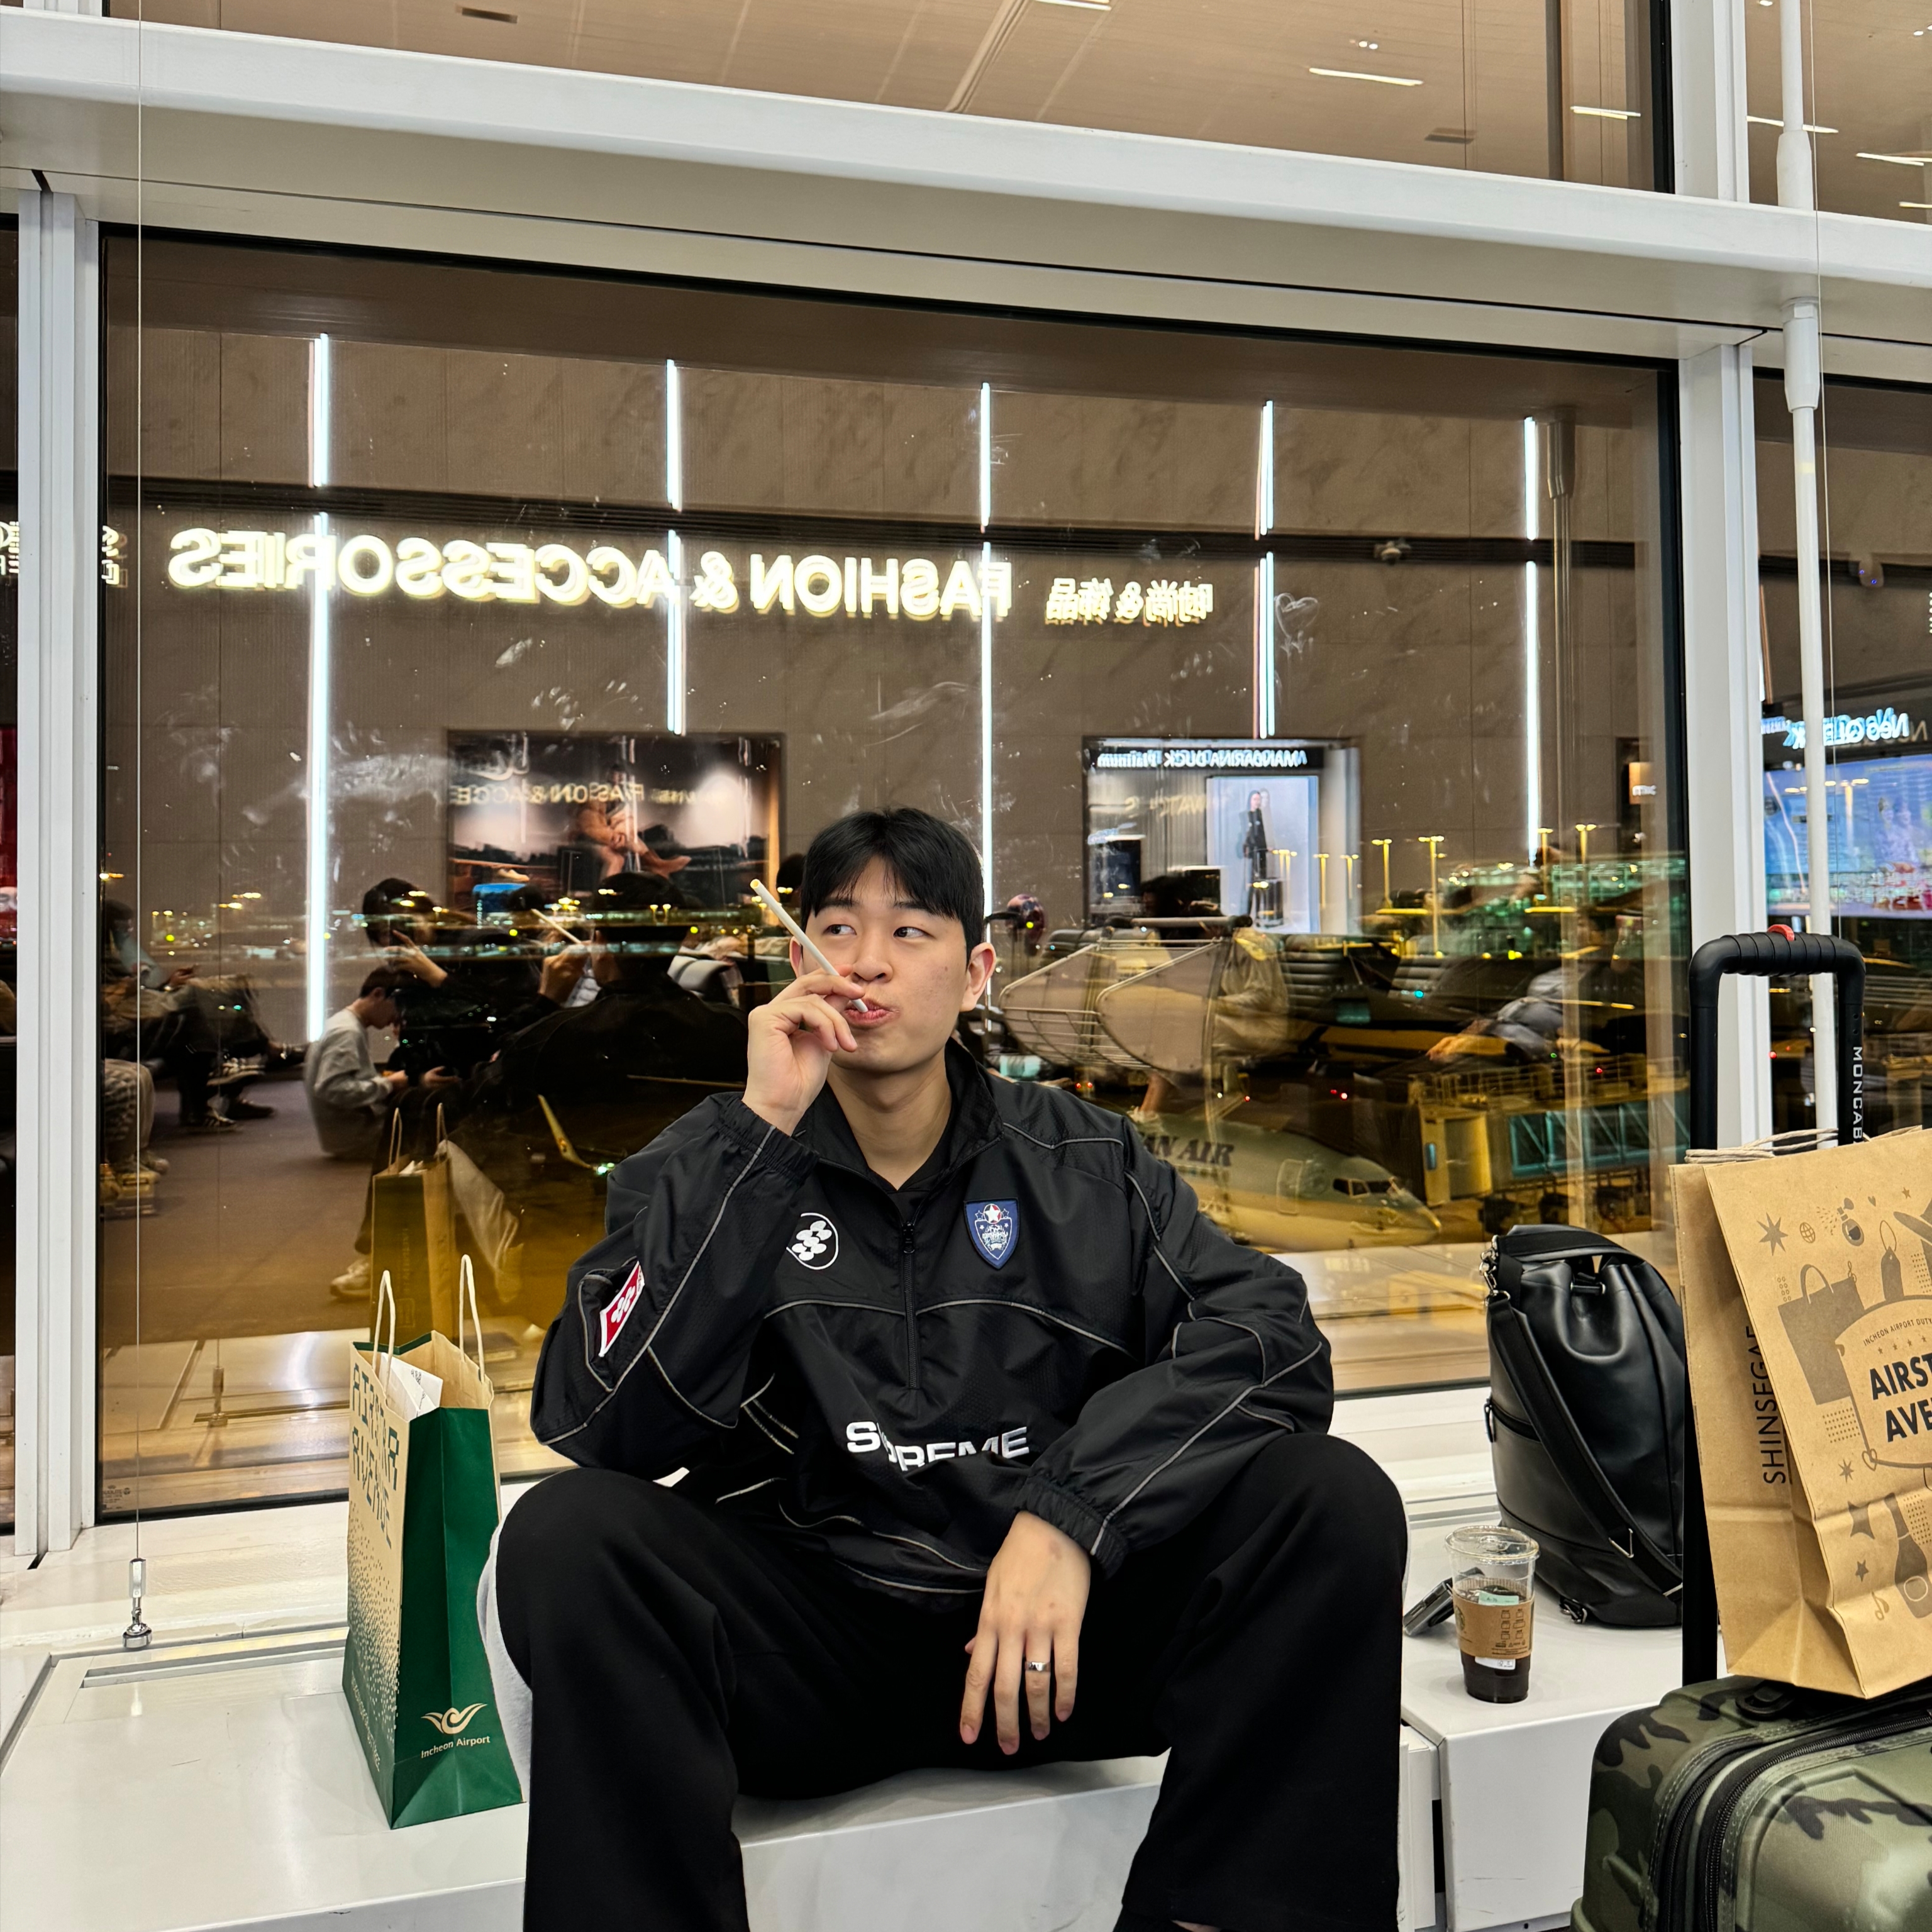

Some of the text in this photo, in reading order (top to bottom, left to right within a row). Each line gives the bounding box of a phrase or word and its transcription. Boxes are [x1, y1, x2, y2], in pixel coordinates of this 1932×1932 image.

[1177, 1139, 1235, 1167] AIR
[1863, 1328, 1889, 1346] INCHEON
[1890, 1319, 1915, 1332] AIRPORT
[1885, 1397, 1932, 1443] AVE
[421, 1735, 491, 1758] Incheon Airport
